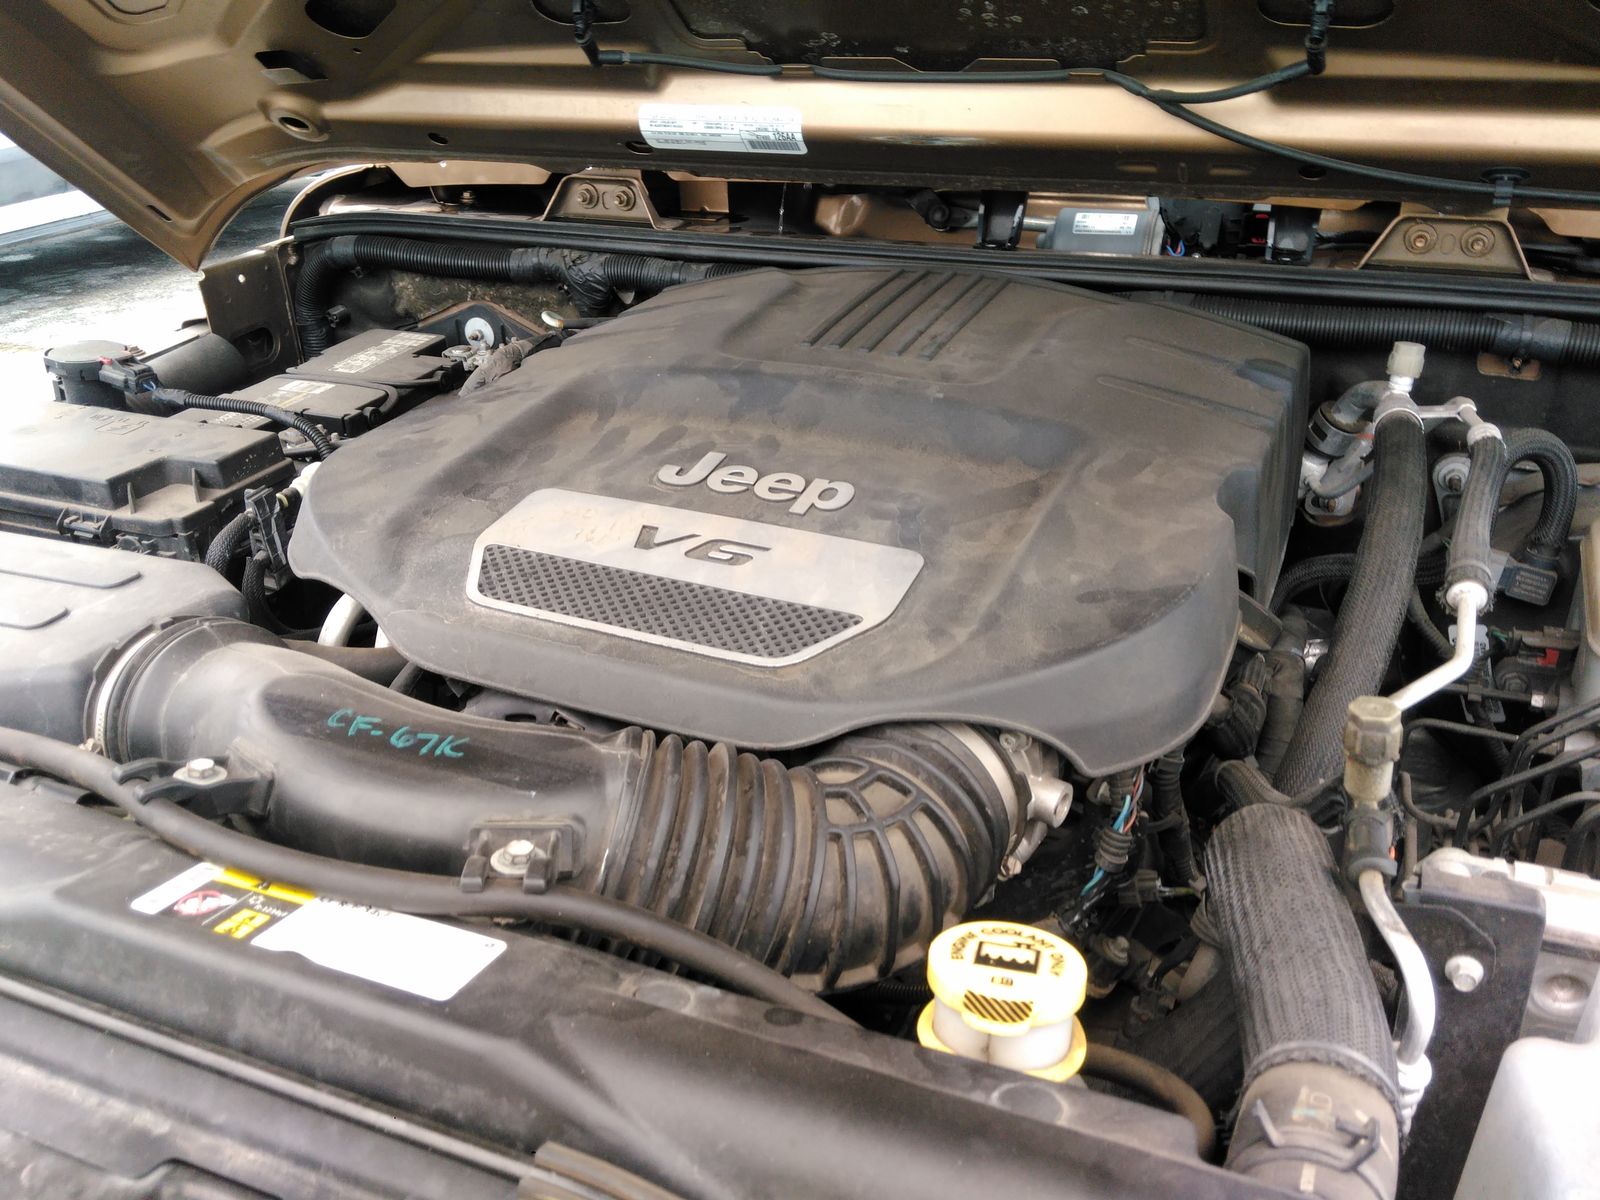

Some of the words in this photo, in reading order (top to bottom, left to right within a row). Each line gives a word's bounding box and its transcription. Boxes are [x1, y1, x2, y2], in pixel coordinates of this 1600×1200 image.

[656, 451, 855, 515] Jeep
[634, 525, 772, 566] V6
[981, 927, 1056, 949] COOLANT
